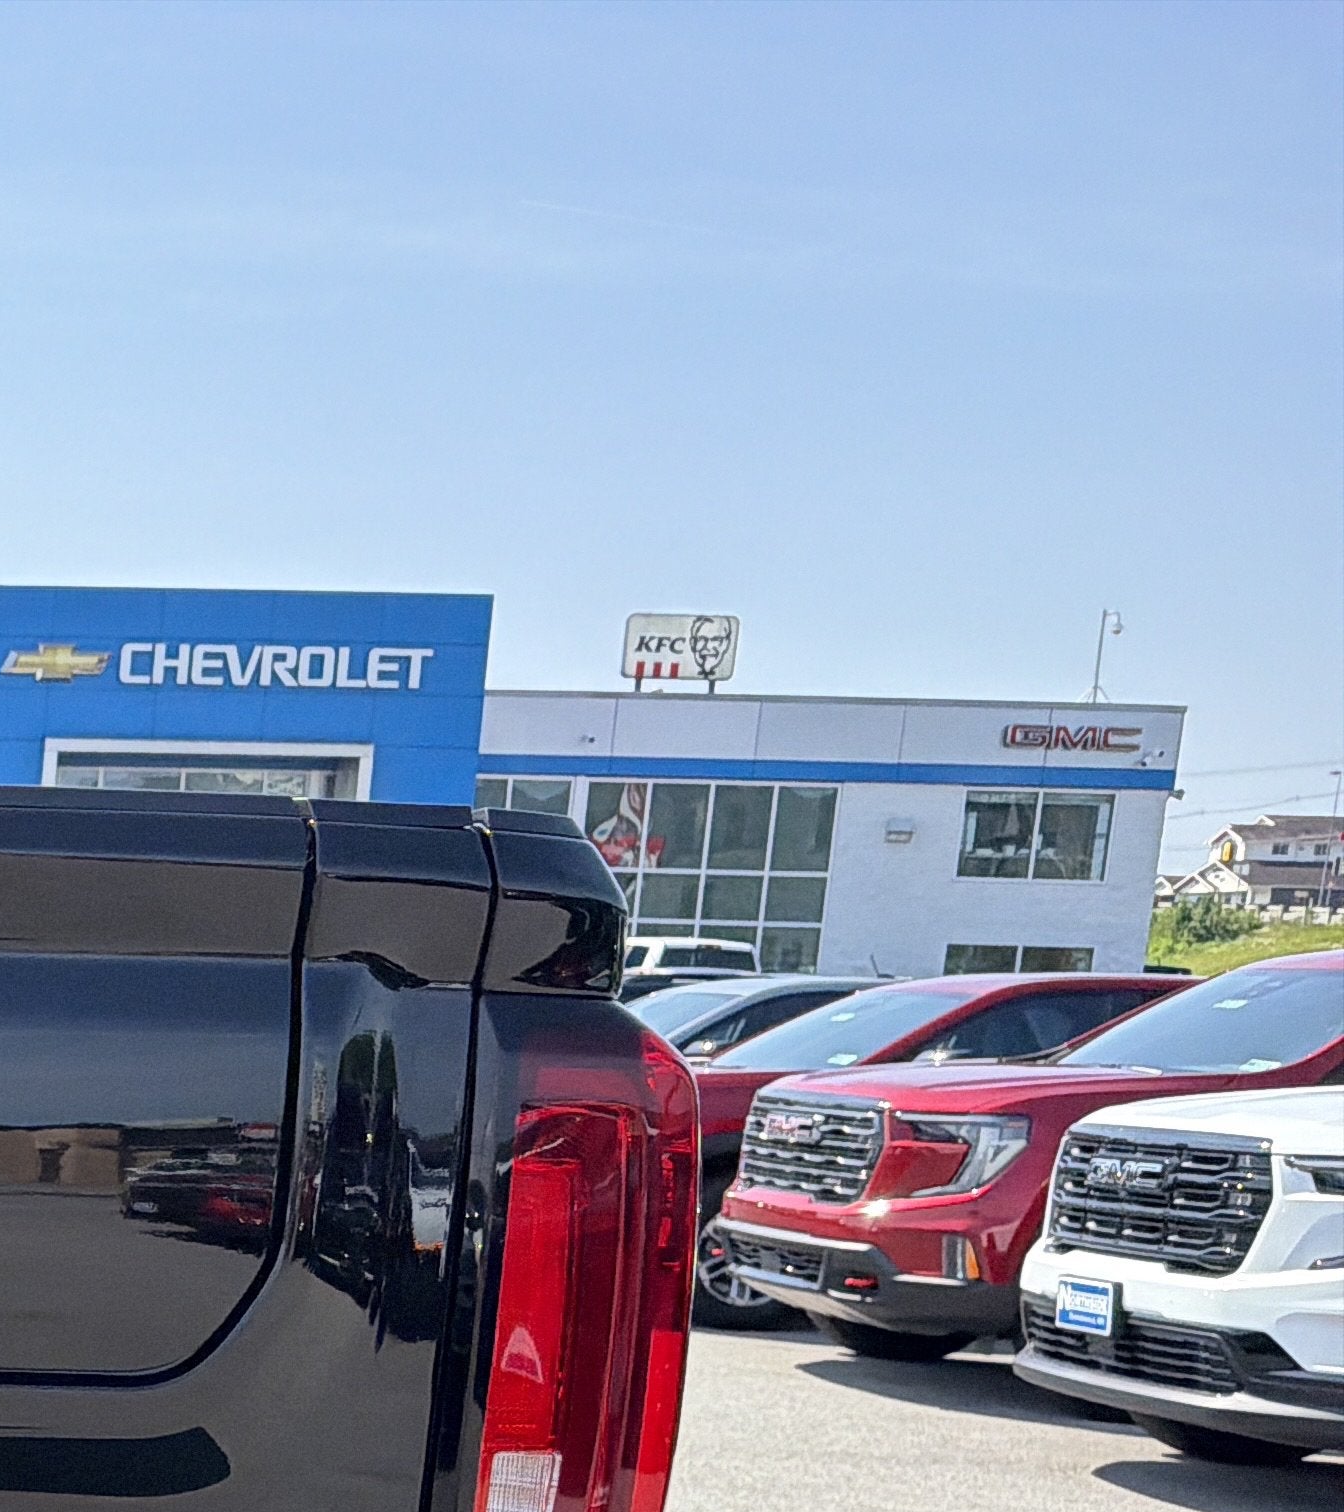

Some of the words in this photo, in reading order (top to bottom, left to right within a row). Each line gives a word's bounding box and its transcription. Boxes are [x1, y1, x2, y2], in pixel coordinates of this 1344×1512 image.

[635, 635, 686, 654] KFC
[119, 642, 434, 689] CHEVROLET
[1004, 724, 1143, 751] GMC
[1087, 1157, 1163, 1188] GMC
